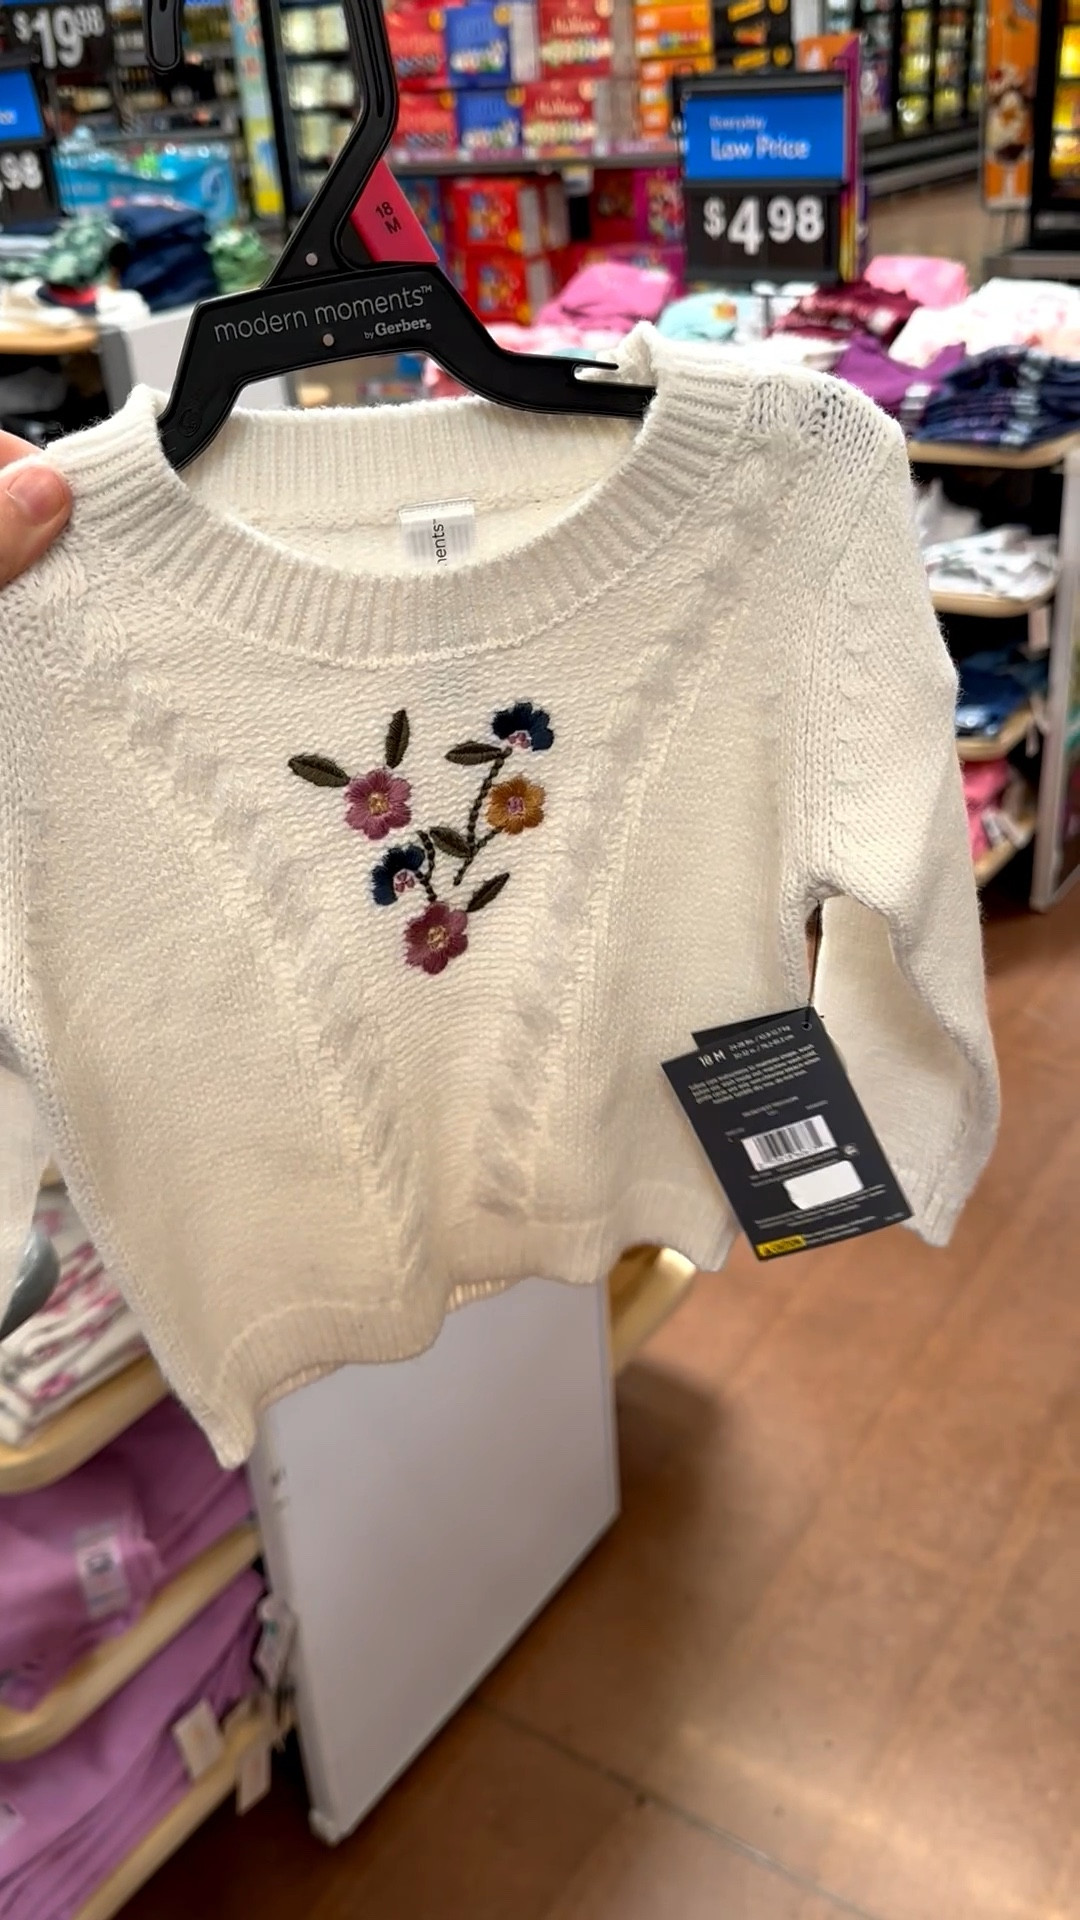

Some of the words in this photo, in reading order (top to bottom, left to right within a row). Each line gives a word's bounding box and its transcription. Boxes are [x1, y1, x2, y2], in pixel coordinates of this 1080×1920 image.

[375, 201, 394, 219] 18
[384, 216, 402, 234] M
[214, 310, 308, 342] modern
[364, 330, 374, 339] by
[712, 1049, 727, 1063] M
